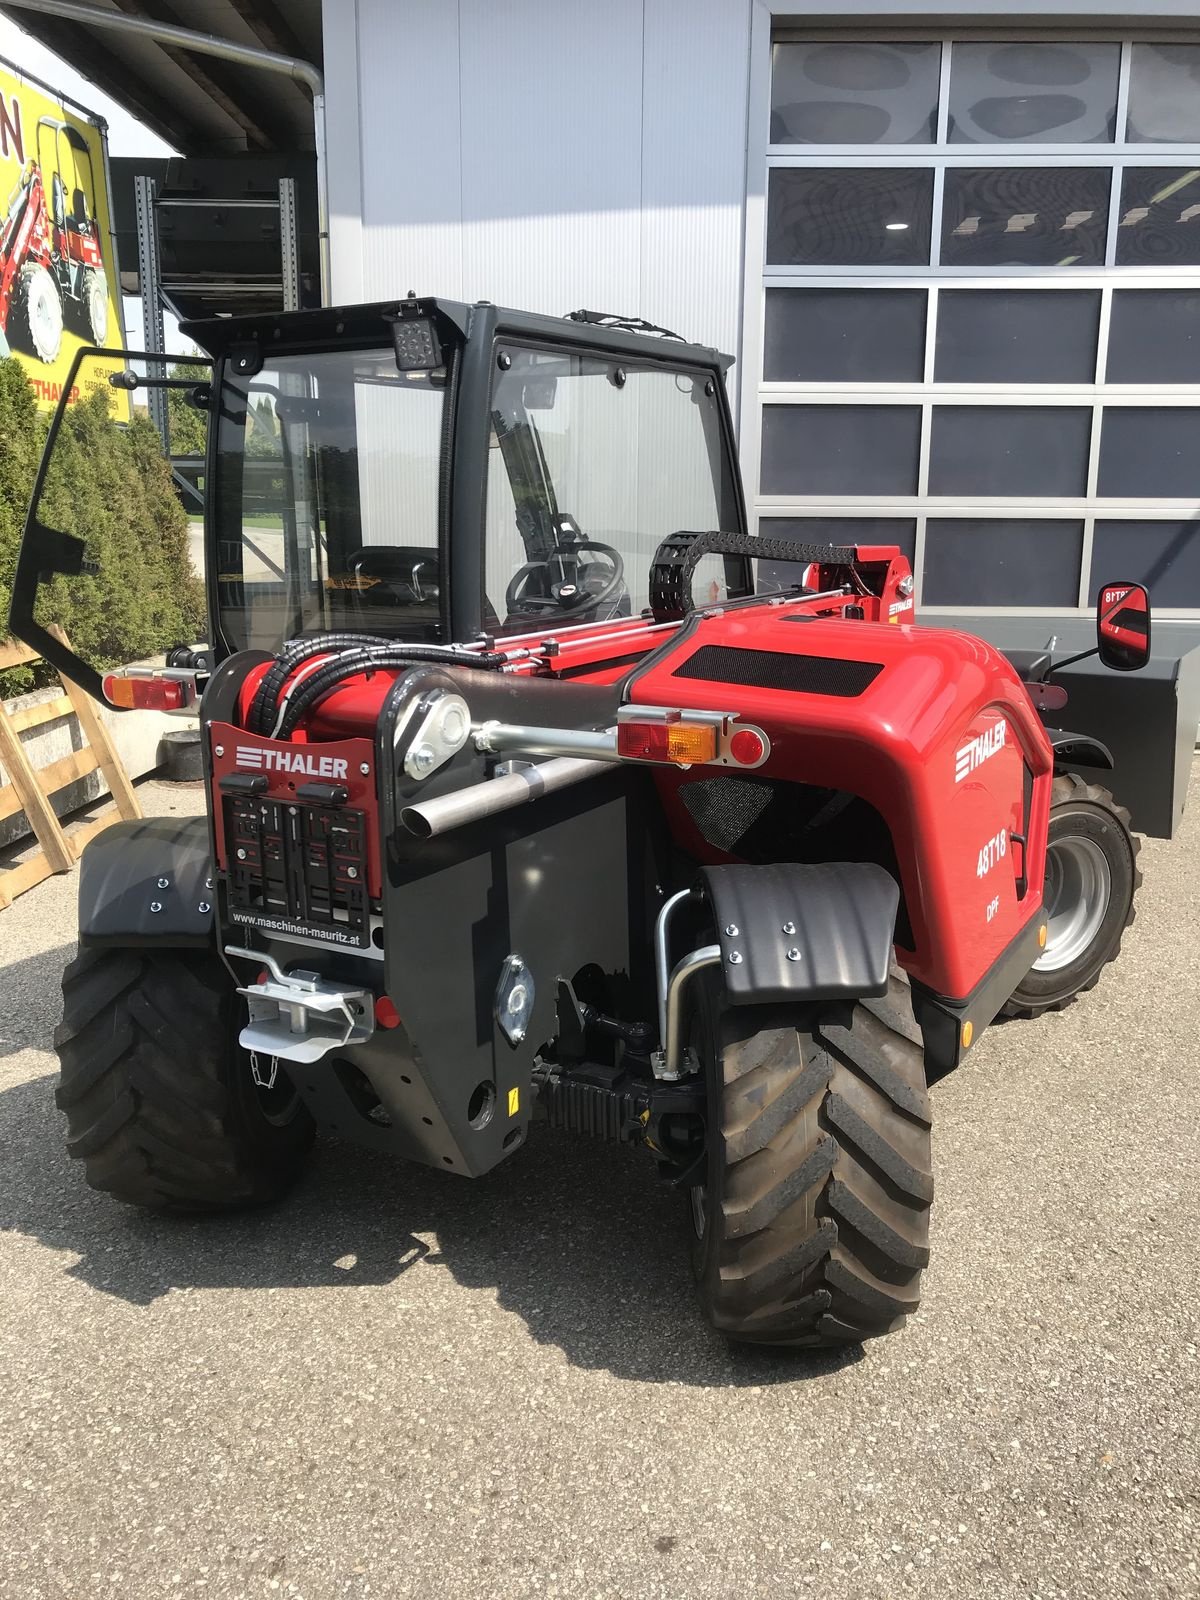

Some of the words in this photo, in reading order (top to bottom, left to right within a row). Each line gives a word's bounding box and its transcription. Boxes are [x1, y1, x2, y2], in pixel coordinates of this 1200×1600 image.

[976, 828, 1006, 879] 48T18
[986, 895, 999, 923] DPF
[233, 913, 360, 945] www.maschinen-mauritz.at
